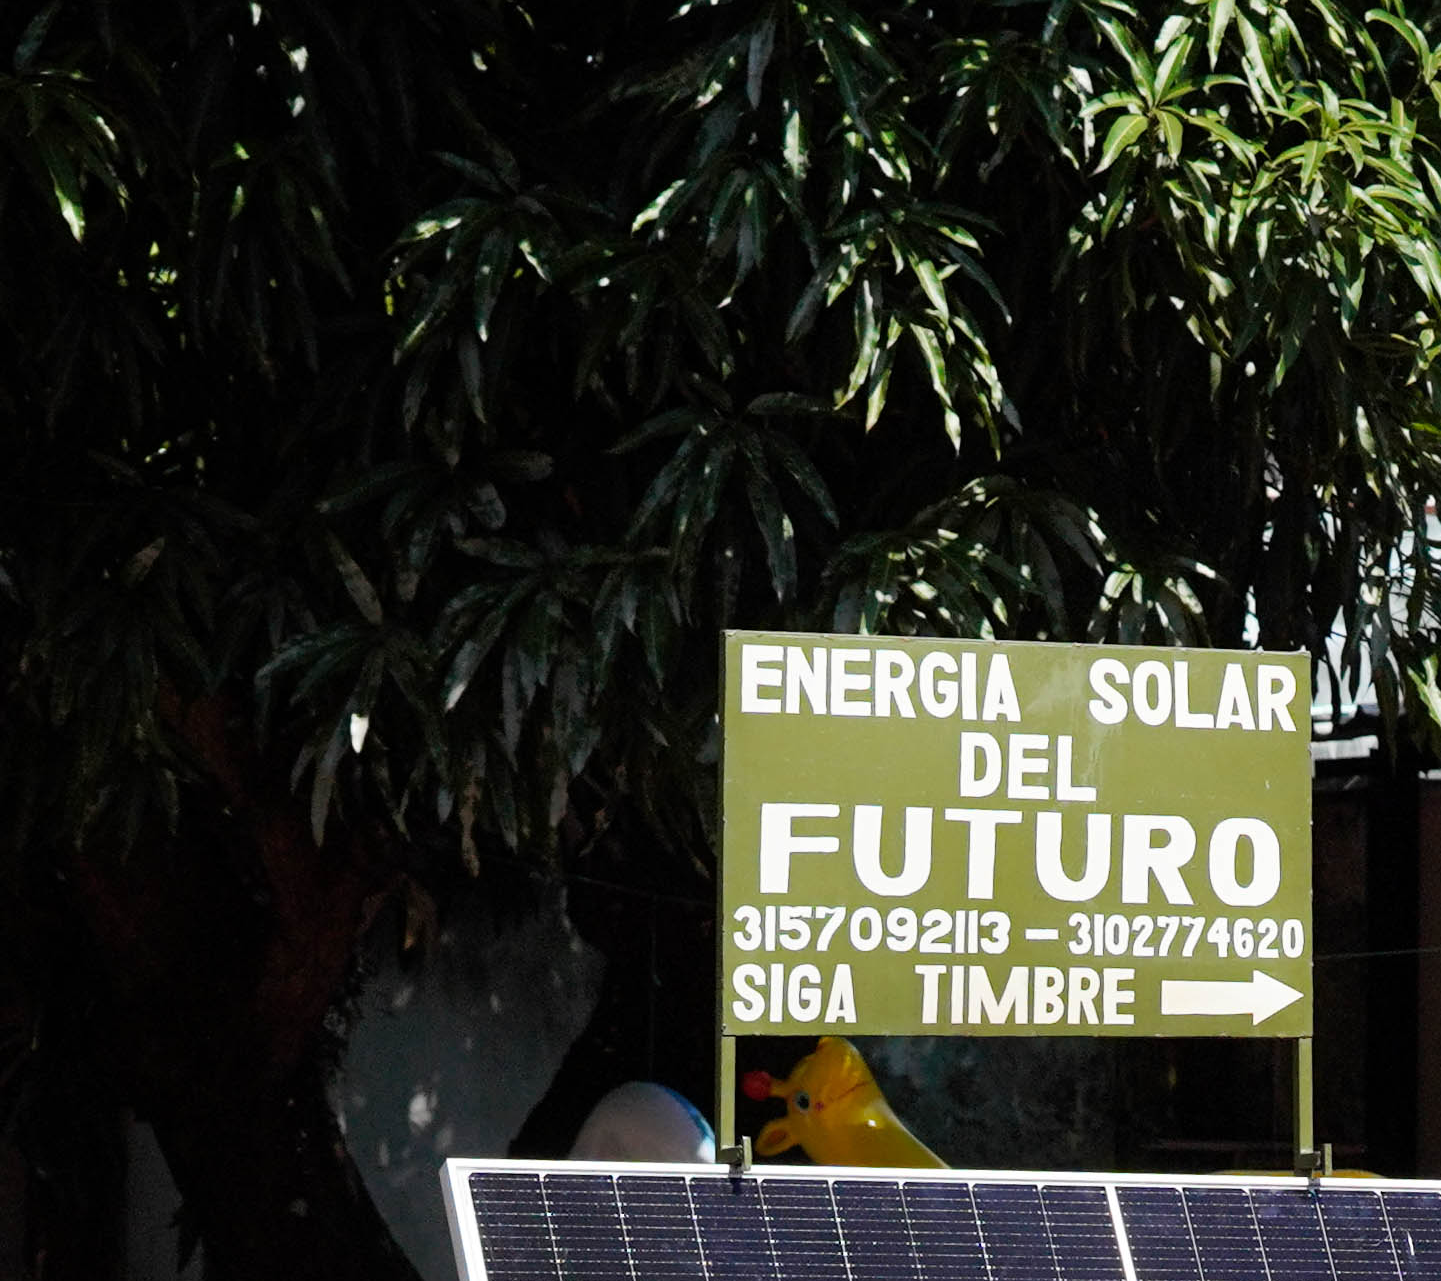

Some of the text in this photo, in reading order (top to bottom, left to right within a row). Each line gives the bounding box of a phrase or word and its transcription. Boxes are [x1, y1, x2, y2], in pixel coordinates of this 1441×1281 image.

[741, 644, 1297, 732] ENERGIA SOLAR
[960, 731, 1097, 802] DEL
[759, 802, 1281, 907] FUTURO
[733, 905, 1011, 955] 3157092113
[1068, 914, 1305, 959] 3102774620
[732, 963, 1135, 1025] SIGA TIMBRE
